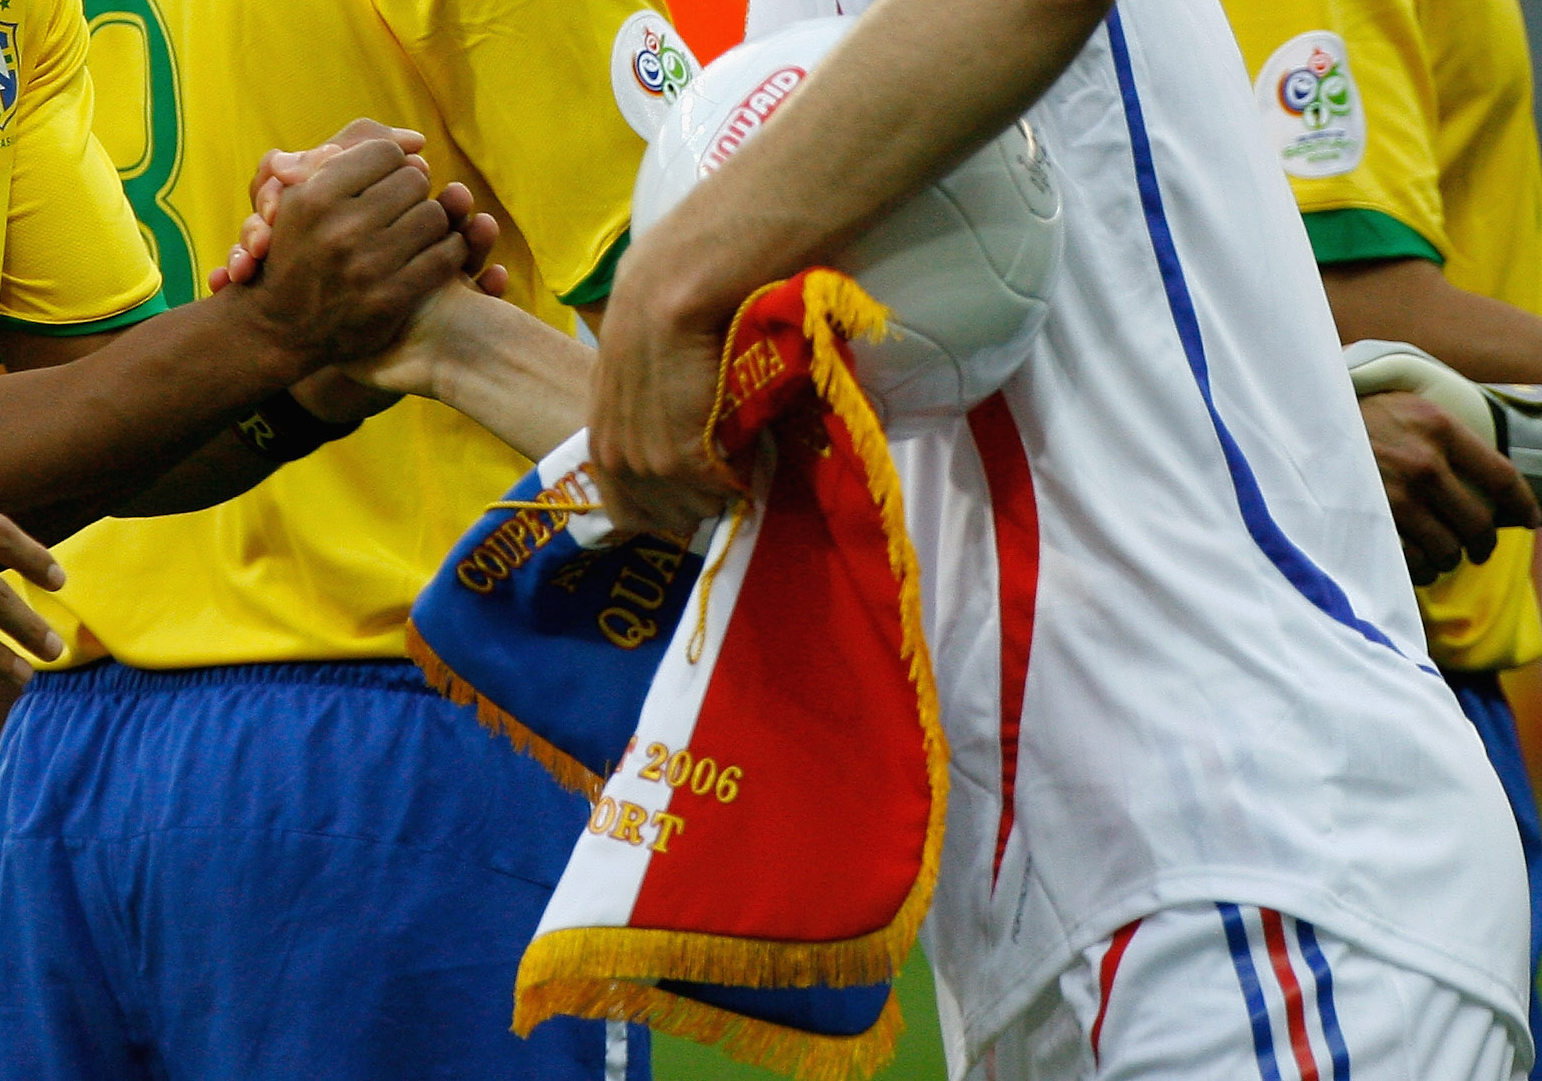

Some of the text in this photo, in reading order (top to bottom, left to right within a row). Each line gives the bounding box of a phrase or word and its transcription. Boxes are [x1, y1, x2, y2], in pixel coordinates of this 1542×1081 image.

[733, 338, 786, 398] FIFA
[456, 507, 553, 595] COUPE
[598, 530, 694, 650] QUA
[638, 741, 743, 804] 2006
